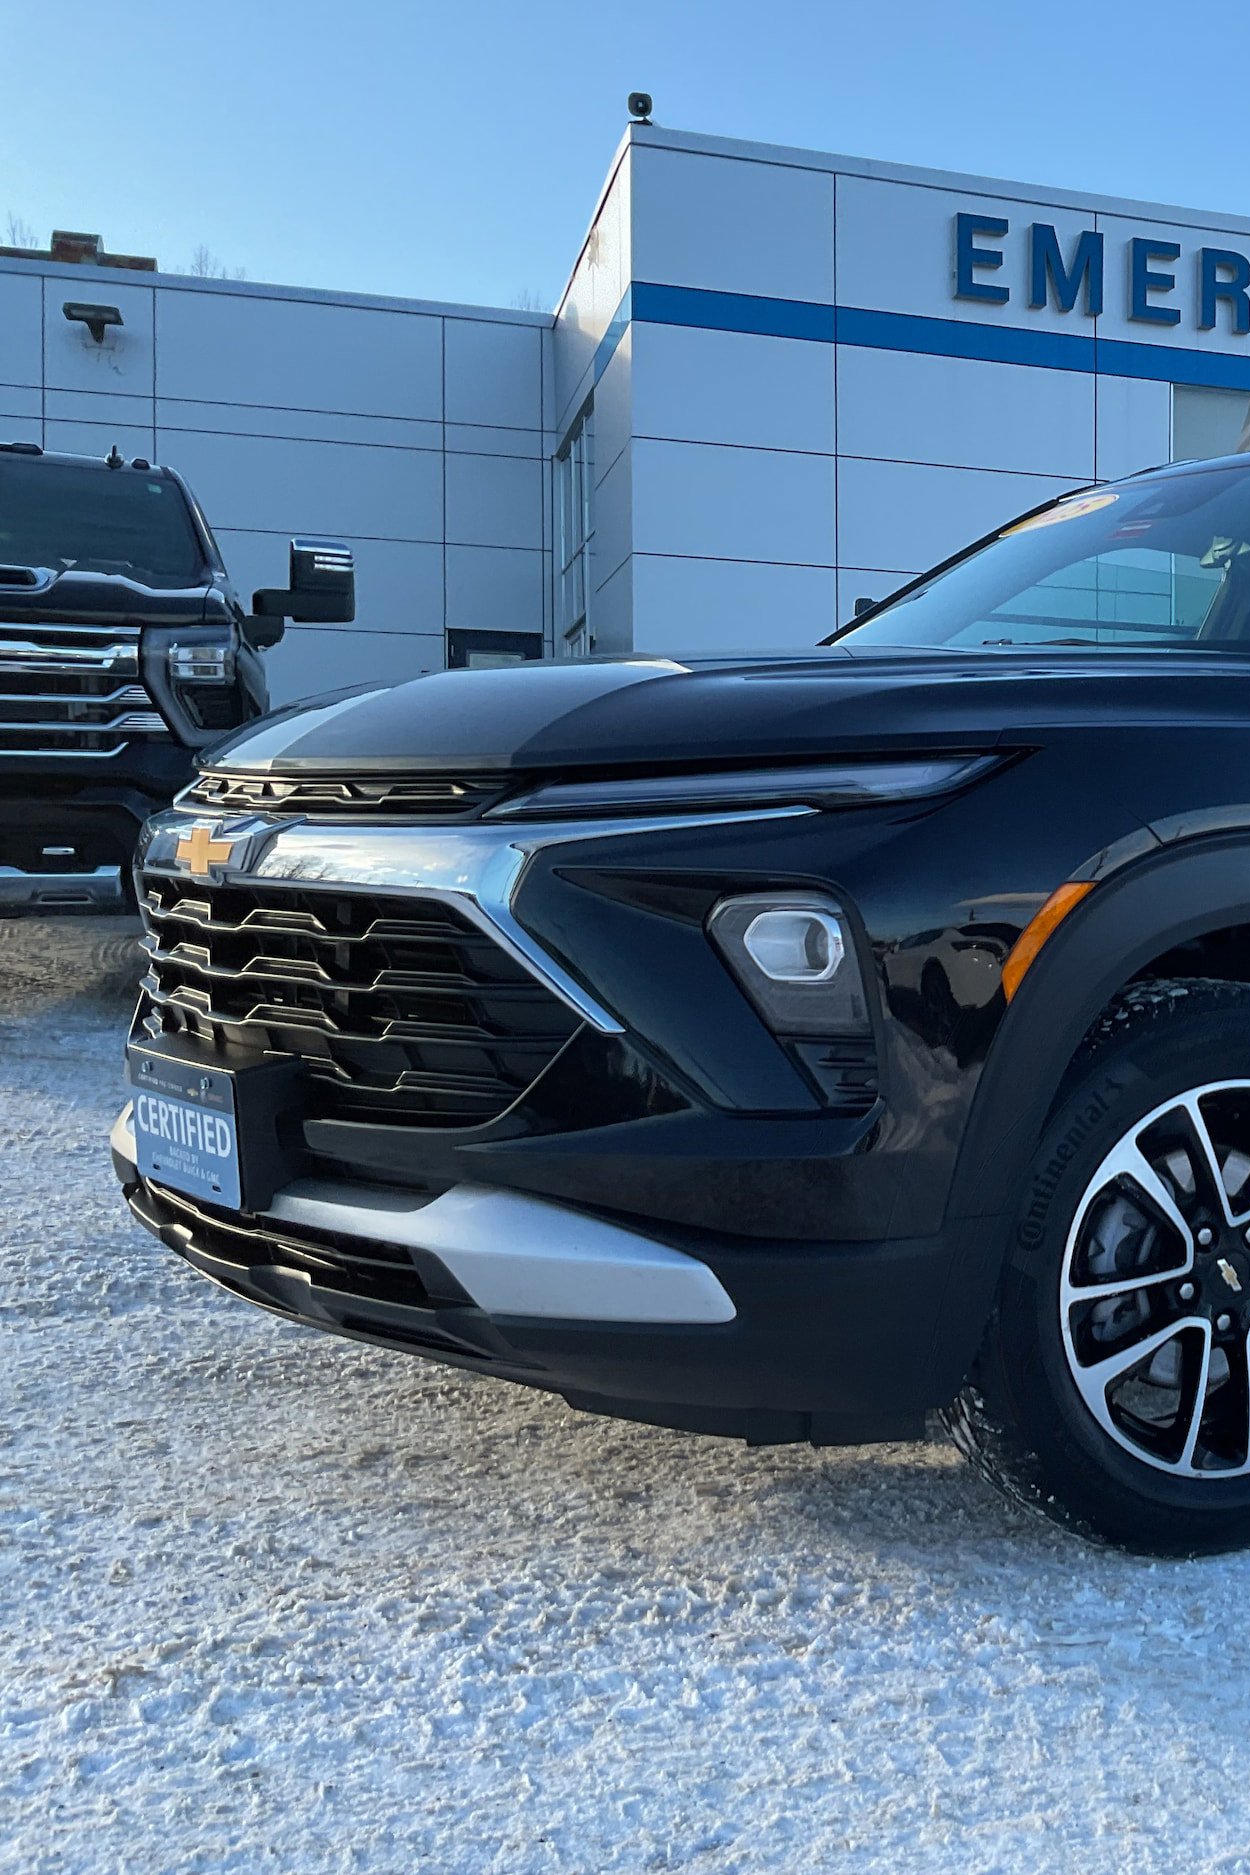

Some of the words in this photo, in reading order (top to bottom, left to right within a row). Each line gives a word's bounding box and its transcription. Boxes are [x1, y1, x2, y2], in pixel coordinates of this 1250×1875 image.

[137, 1094, 231, 1158] CERTIFIED
[152, 1152, 182, 1173] CHEVROLET
[183, 1162, 200, 1178] BUICK
[206, 1170, 221, 1185] GMC
[169, 1146, 189, 1161] BACKED
[189, 1154, 199, 1164] BY
[1017, 1091, 1110, 1251] Continental
